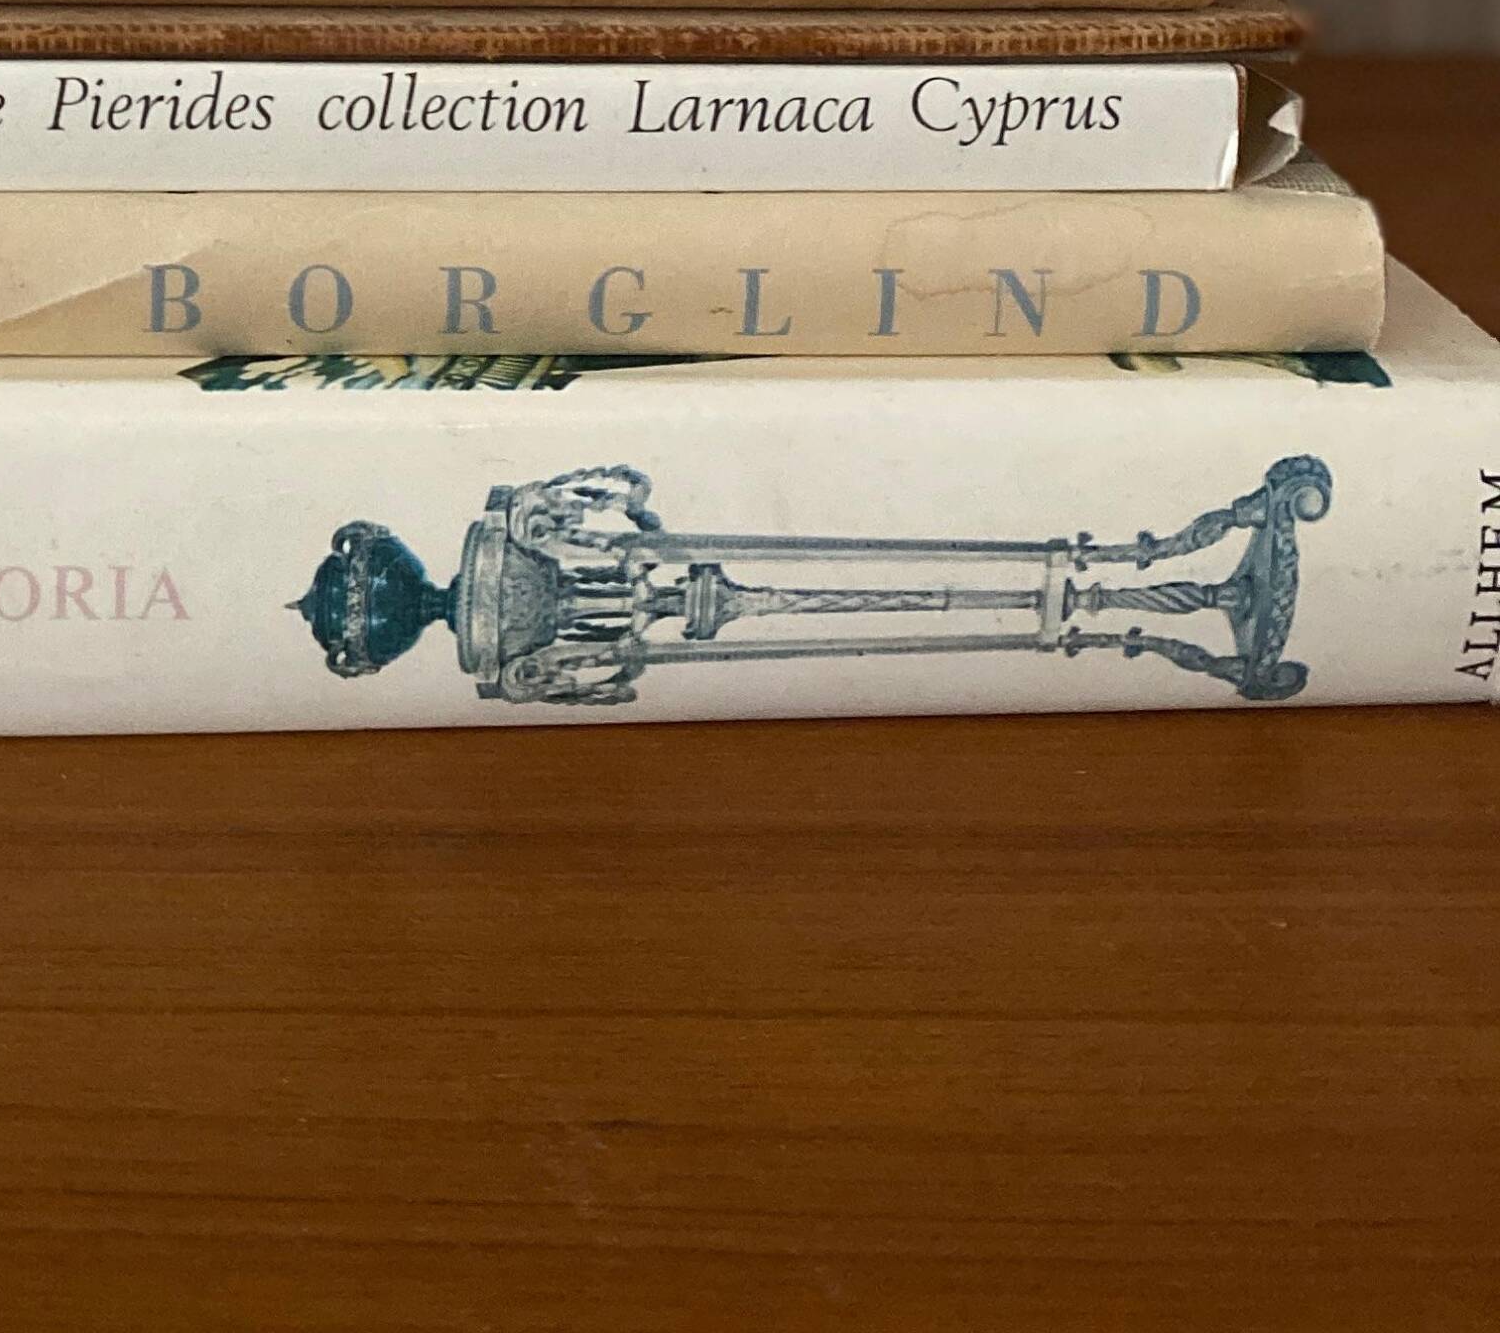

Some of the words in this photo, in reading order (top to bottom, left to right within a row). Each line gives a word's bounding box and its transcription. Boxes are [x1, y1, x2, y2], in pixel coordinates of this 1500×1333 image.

[47, 70, 274, 132] Pierides
[318, 72, 589, 133] collection
[627, 79, 874, 134] Larnaca
[911, 76, 1123, 147] Cyprus
[142, 264, 1203, 338] BORGLIND
